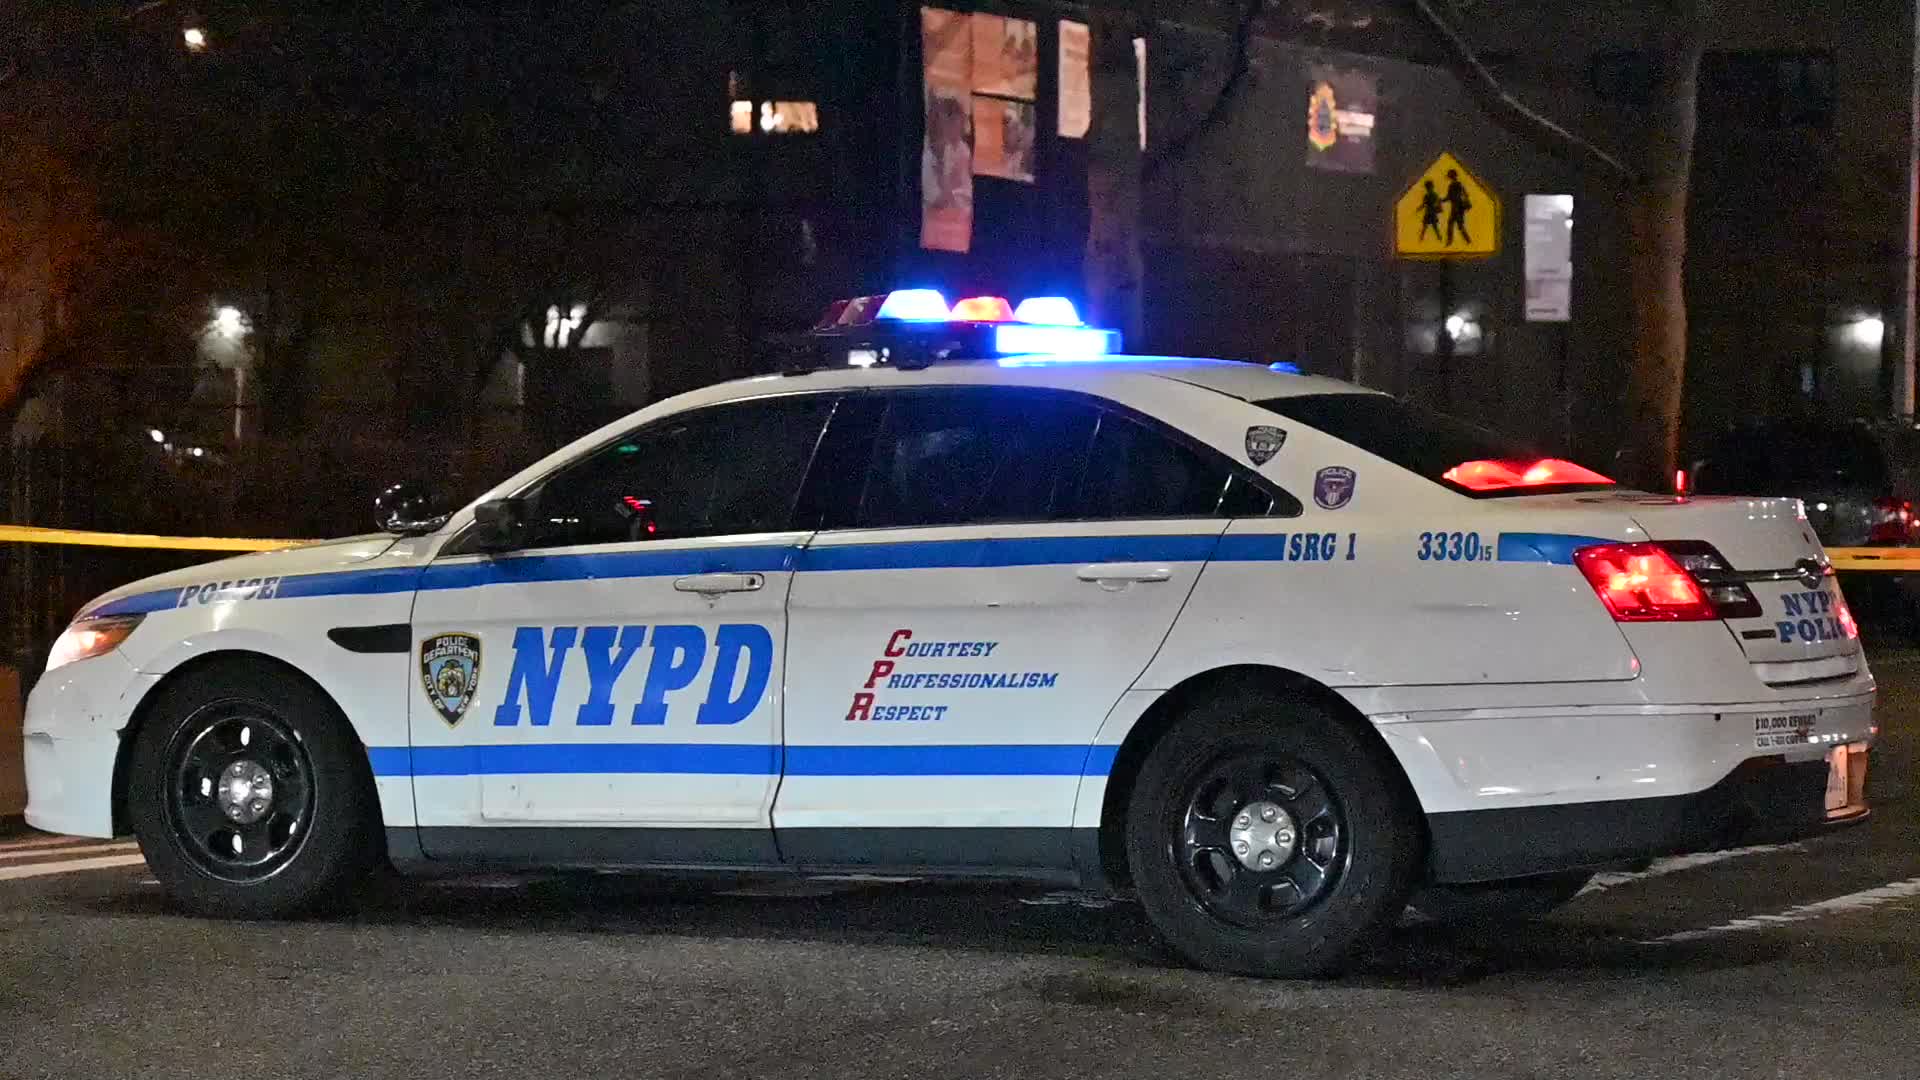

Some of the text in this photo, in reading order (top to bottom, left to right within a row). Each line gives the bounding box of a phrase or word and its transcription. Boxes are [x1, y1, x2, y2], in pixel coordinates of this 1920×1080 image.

[1287, 533, 1357, 561] SRG 1
[1417, 532, 1480, 561] 3330
[178, 576, 280, 608] POCE
[423, 646, 478, 663] DEPARTMENT
[436, 636, 469, 648] POLICE
[884, 629, 998, 657] COURTESY
[493, 624, 774, 727] NYPD
[864, 660, 1059, 689] PROFESSIONALISM
[845, 692, 948, 721] RESPECT
